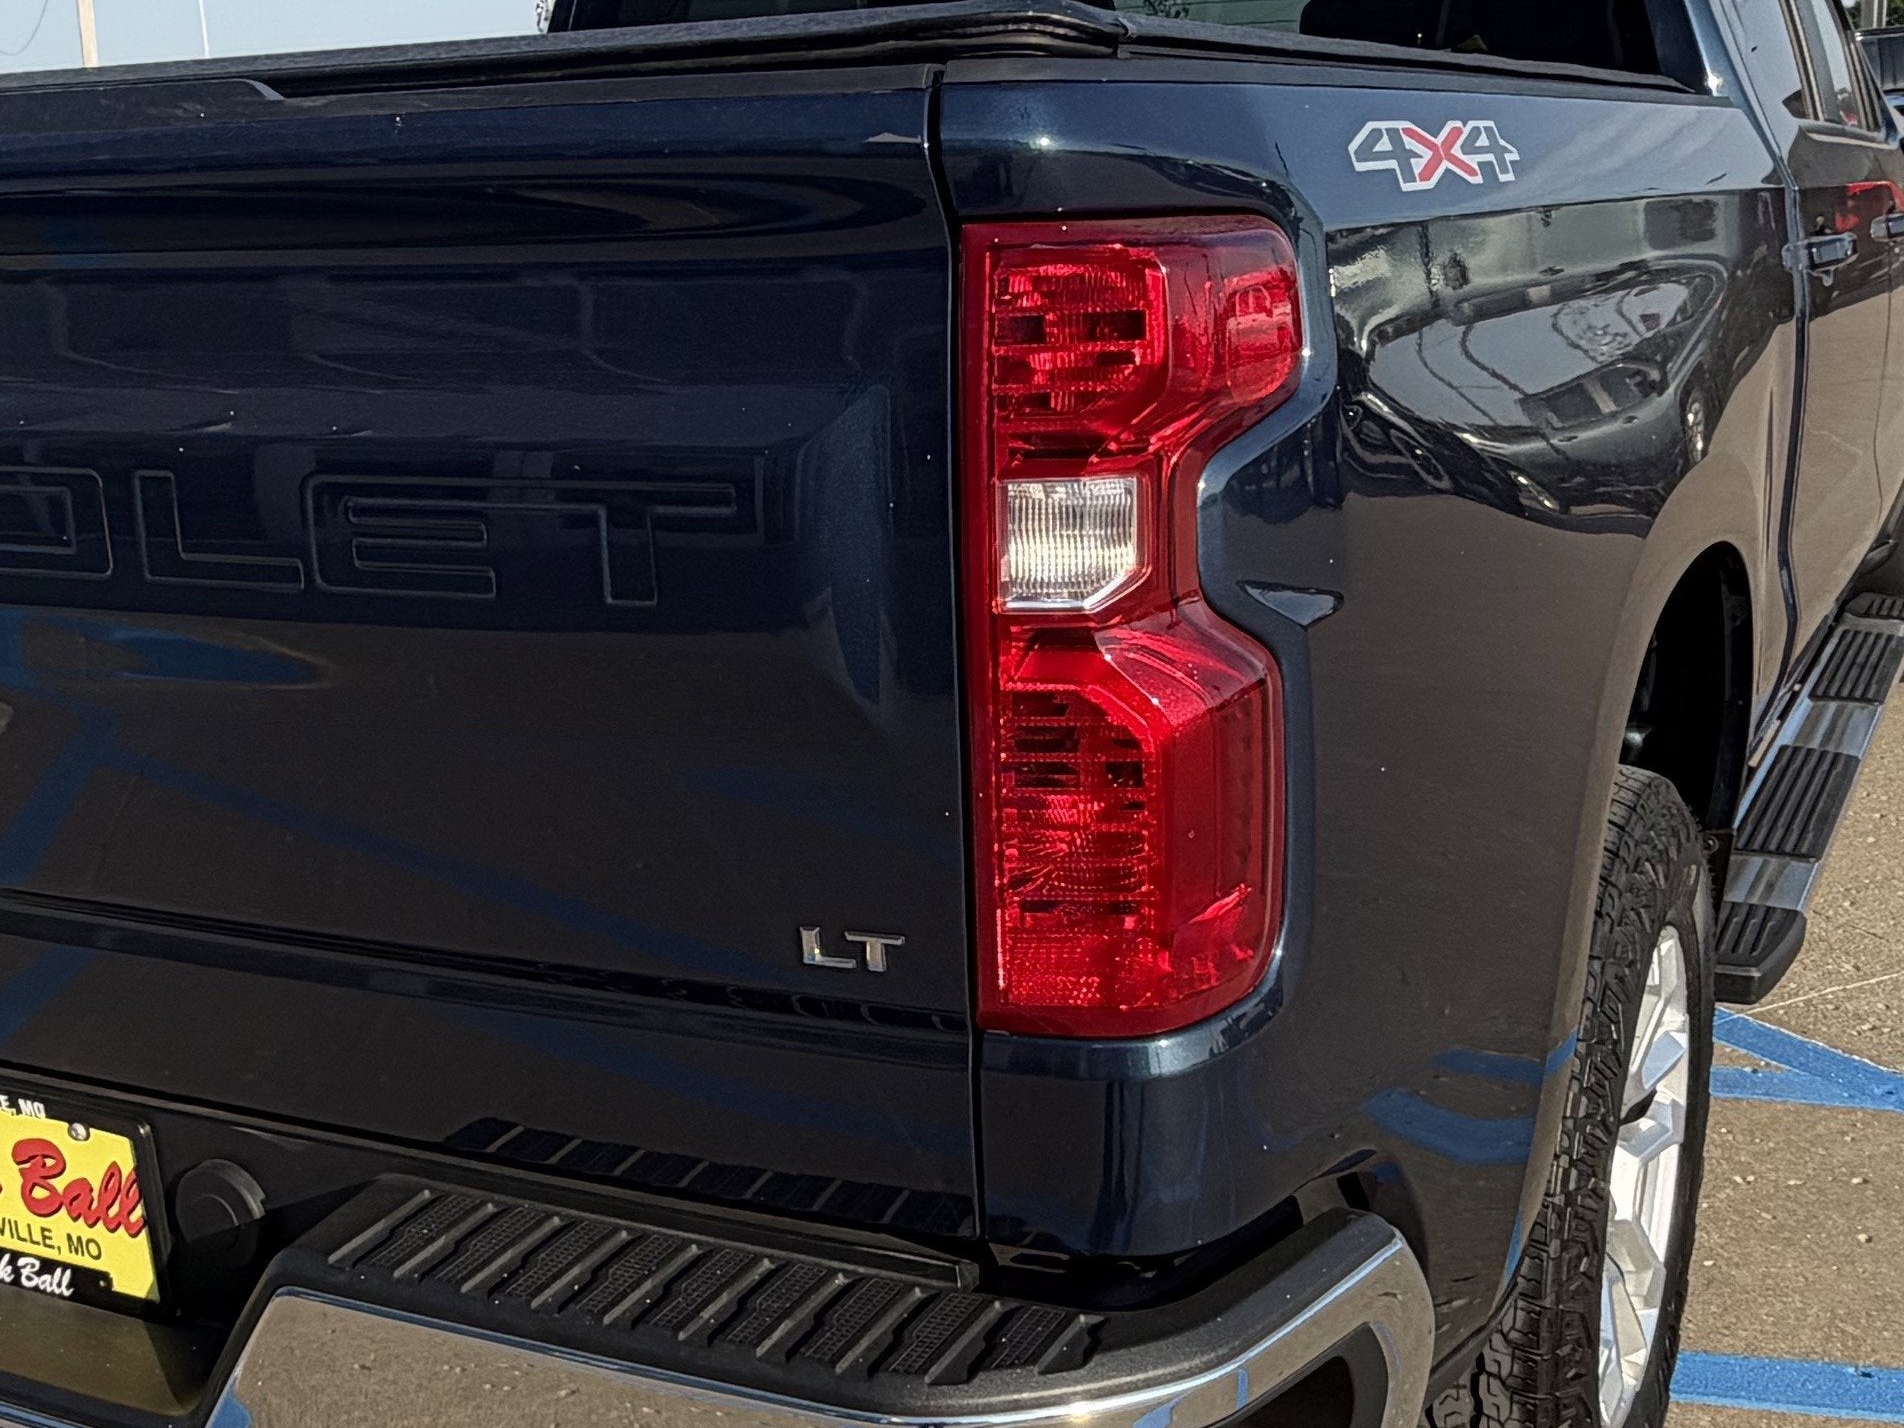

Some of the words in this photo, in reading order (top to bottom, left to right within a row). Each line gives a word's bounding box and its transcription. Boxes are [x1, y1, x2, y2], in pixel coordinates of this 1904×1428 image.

[799, 926, 906, 972] LT
[18, 1098, 47, 1119] MO
[12, 1137, 149, 1238] Ball
[67, 1232, 103, 1262] MO
[15, 1260, 74, 1298] Ball
